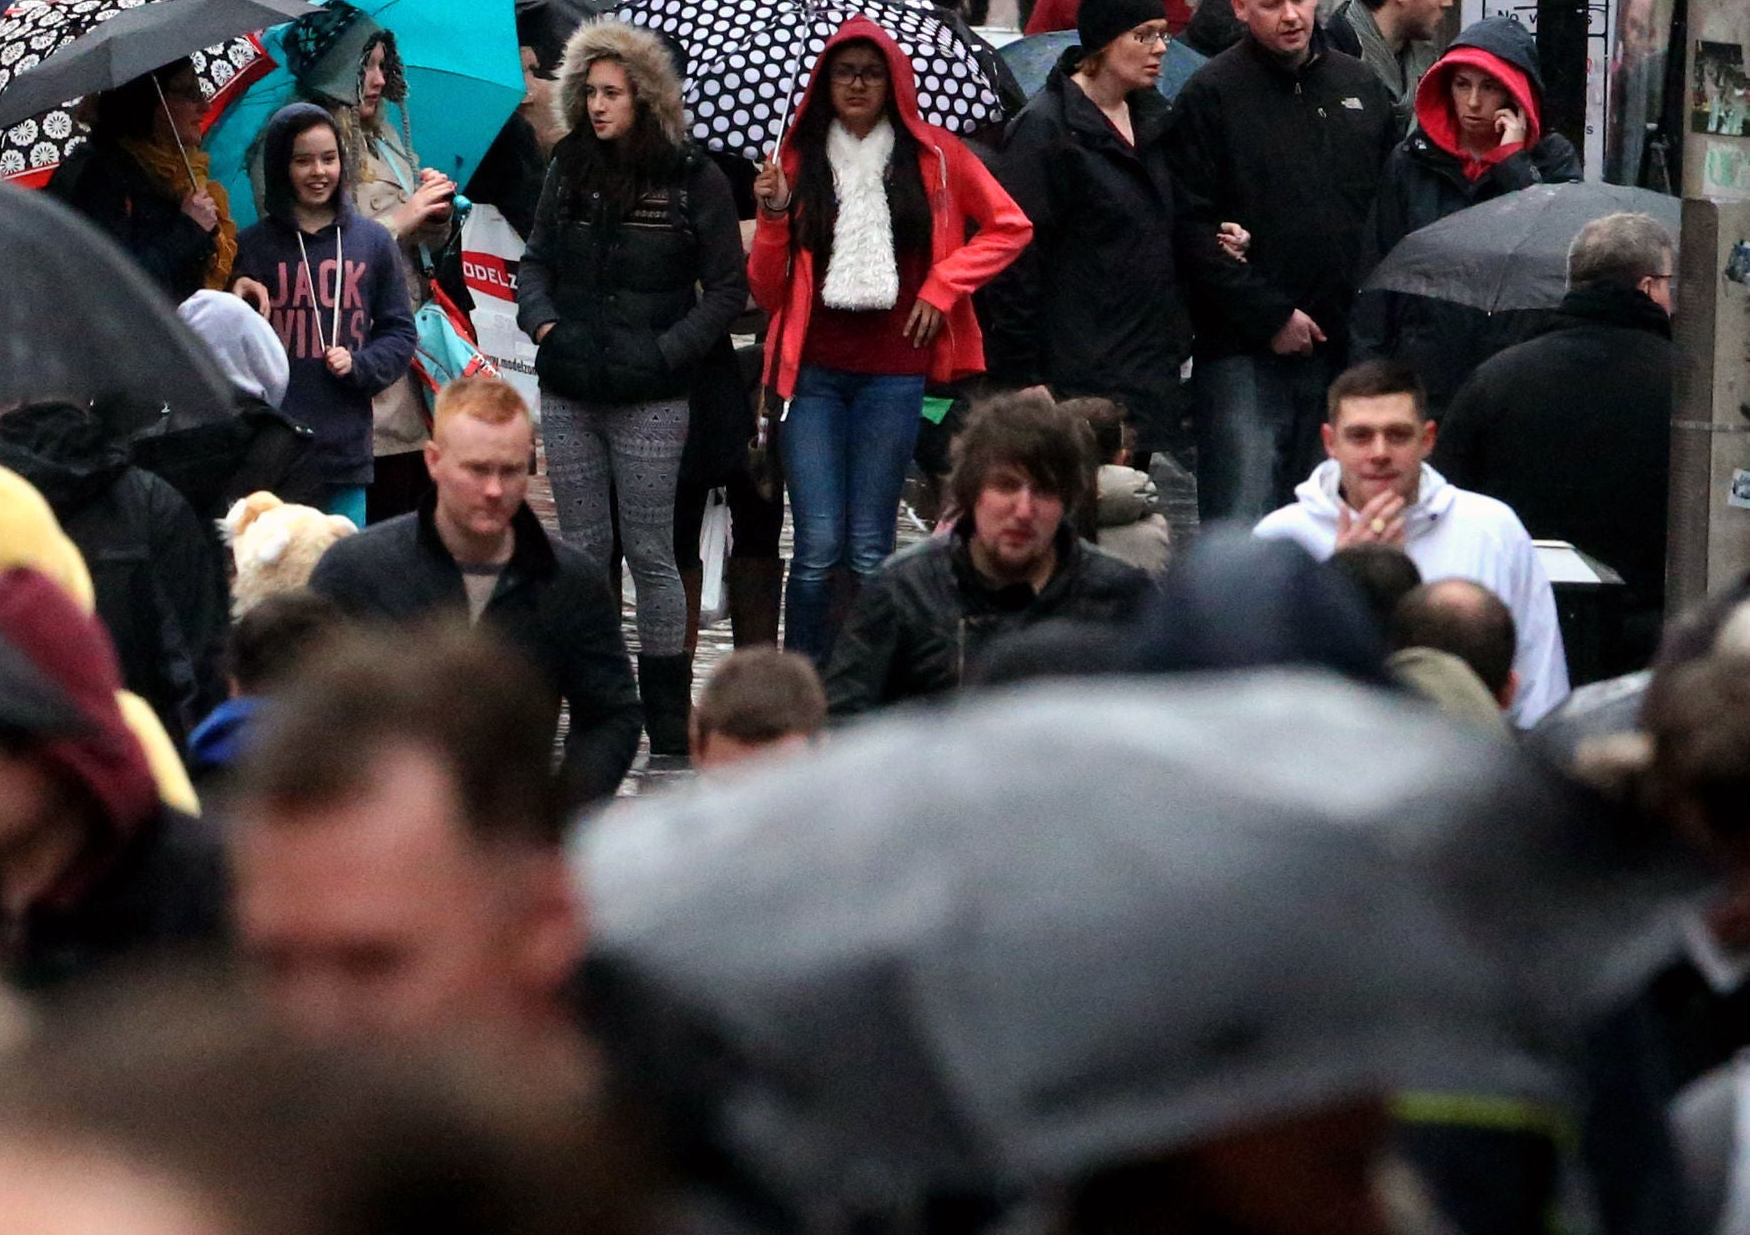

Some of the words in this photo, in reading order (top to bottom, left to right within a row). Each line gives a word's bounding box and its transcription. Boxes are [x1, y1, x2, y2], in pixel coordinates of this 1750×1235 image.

[270, 259, 366, 309] JACK
[462, 260, 518, 290] ODELZ
[272, 308, 366, 358] ILS
